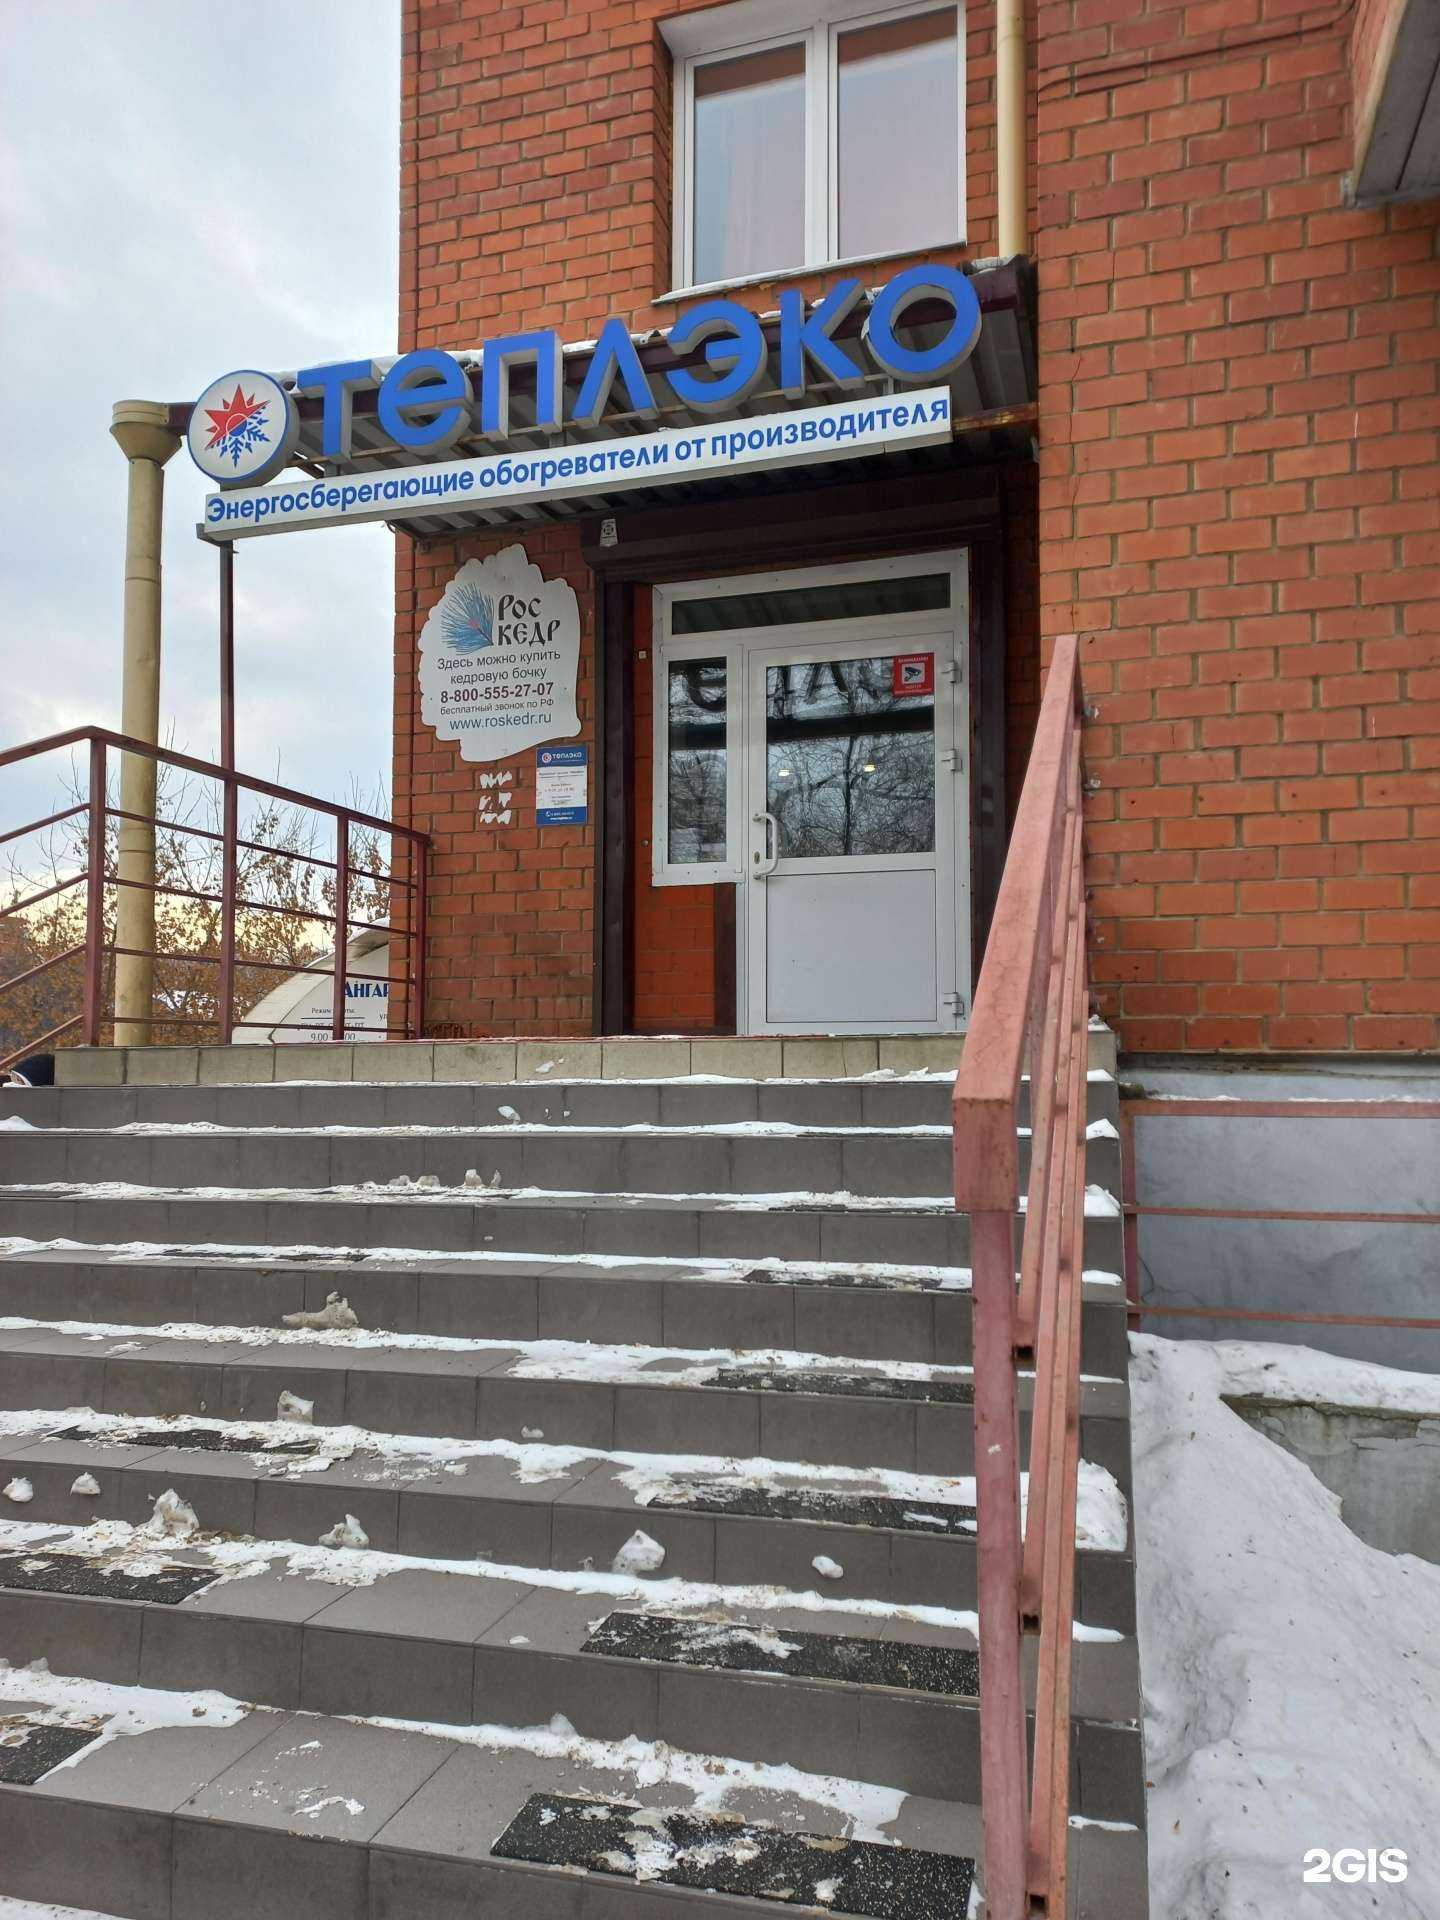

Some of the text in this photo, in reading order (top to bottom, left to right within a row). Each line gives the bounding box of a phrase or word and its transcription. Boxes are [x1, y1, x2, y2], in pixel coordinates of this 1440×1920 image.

[207, 399, 949, 523] Энергосберегающие обогреватели от производителя
[437, 650, 561, 671] Здесь можно купить
[450, 667, 547, 686] кедровую бочку
[440, 682, 554, 703] 8-800-555-27-07
[440, 703, 493, 715] бесплатный
[495, 702, 524, 711] звонок
[540, 698, 554, 707] РФ
[450, 712, 552, 730] www.roskedr.ru
